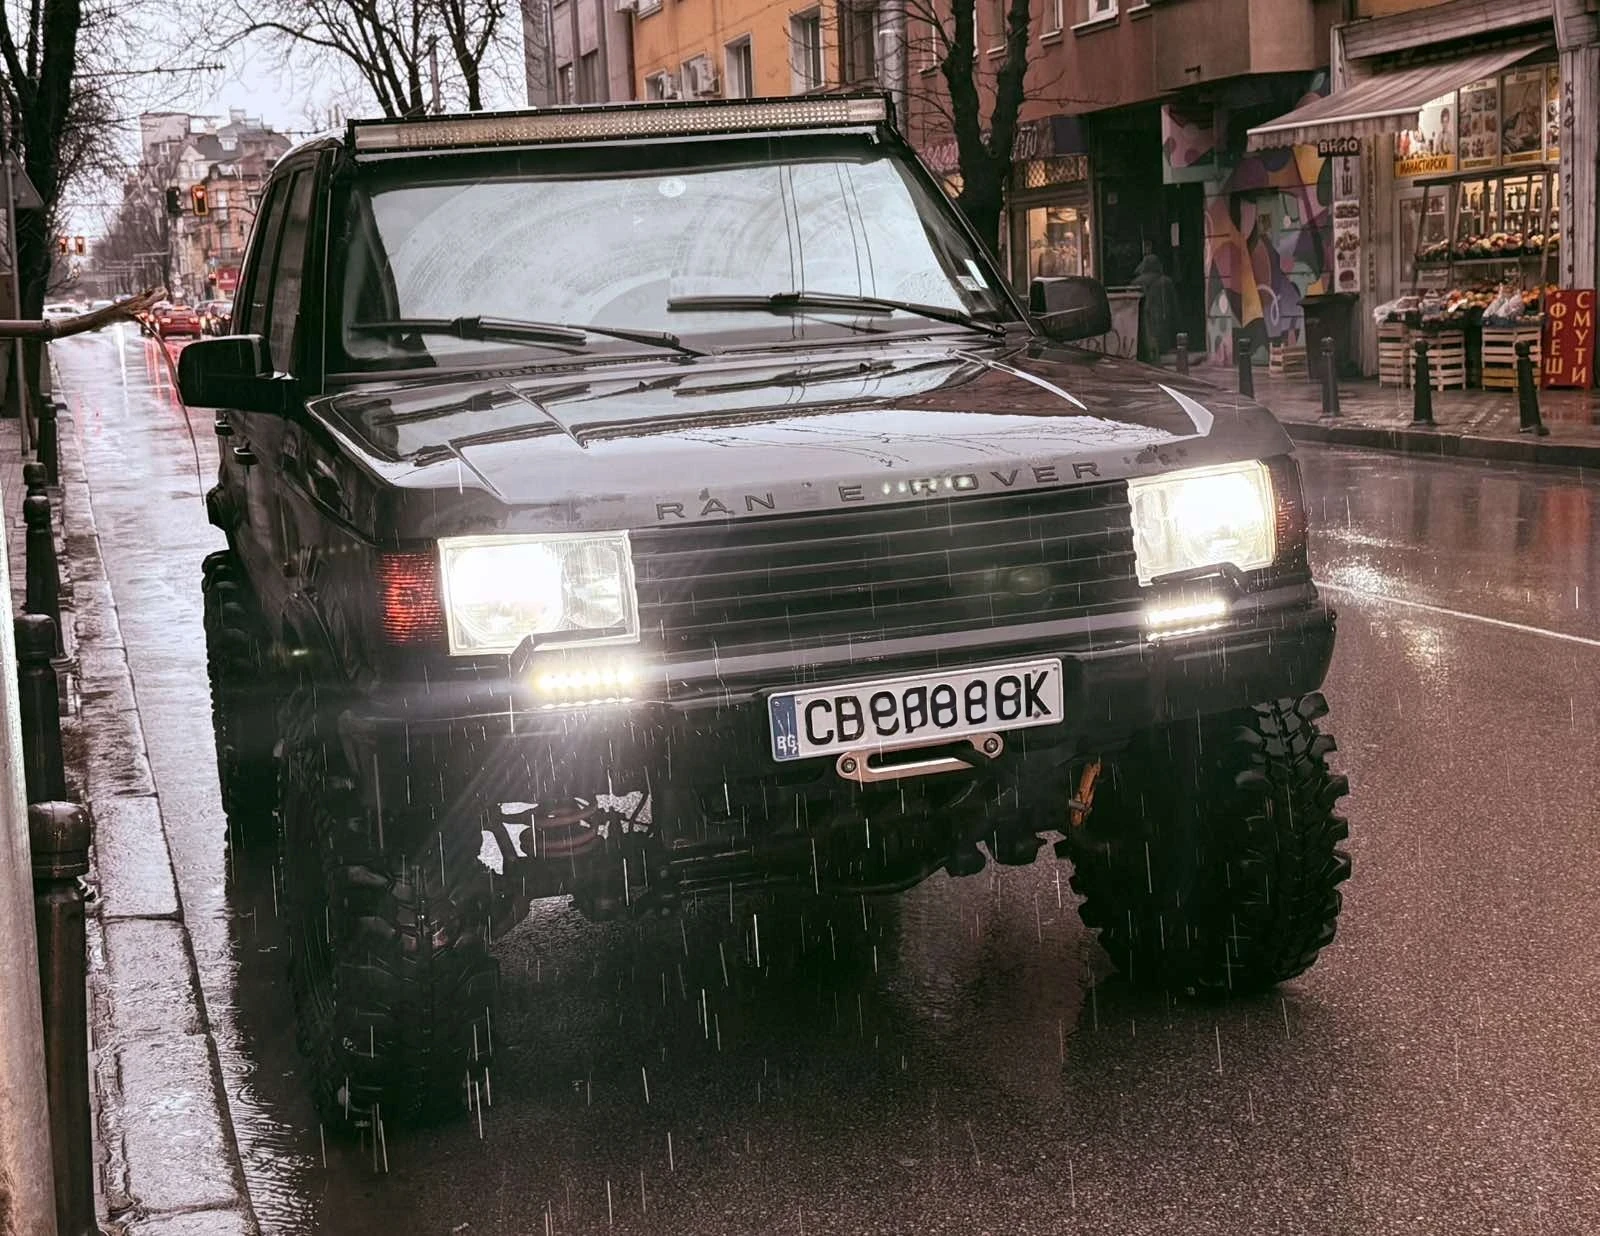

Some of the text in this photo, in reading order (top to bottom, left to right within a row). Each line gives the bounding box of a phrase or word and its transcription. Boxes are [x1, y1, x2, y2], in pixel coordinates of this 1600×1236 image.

[1545, 302, 1567, 374] ФРЕШ
[1572, 291, 1591, 383] СМУТИ
[908, 462, 1100, 496] ROVER
